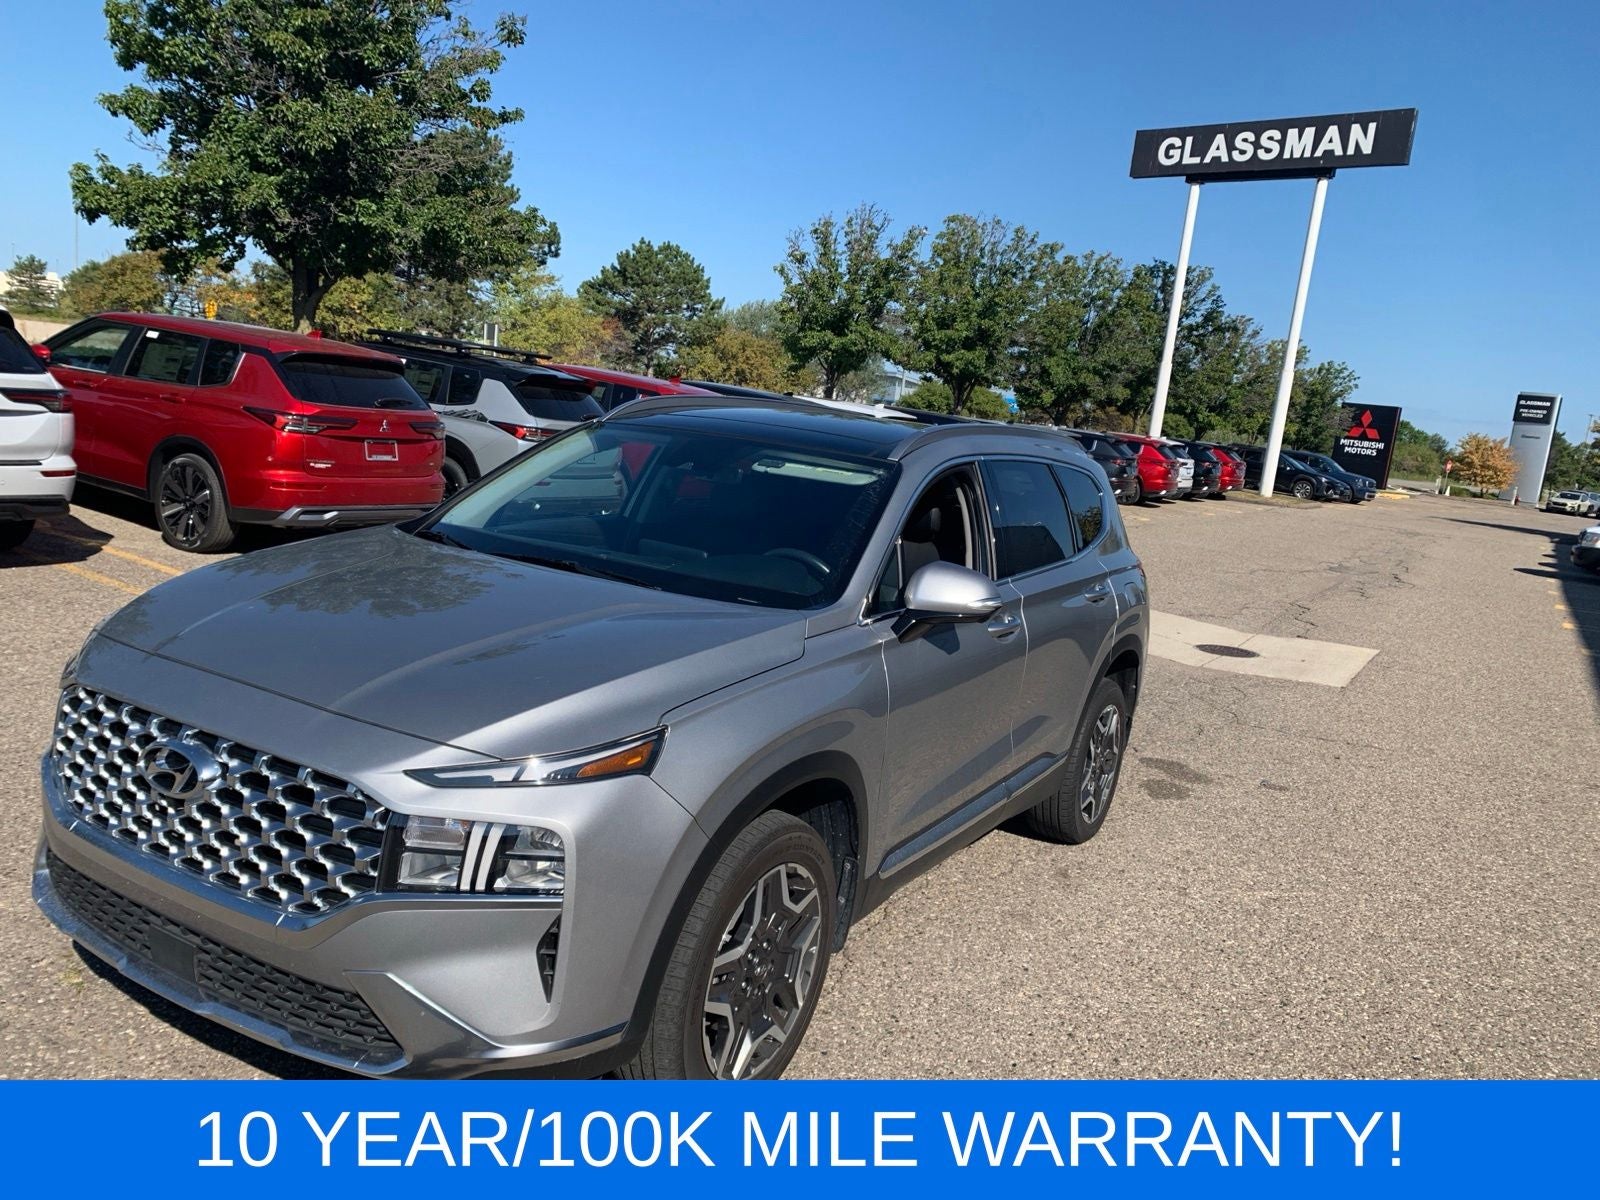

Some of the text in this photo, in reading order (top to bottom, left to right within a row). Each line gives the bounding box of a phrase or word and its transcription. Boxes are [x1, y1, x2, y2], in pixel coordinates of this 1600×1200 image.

[1157, 122, 1377, 166] GLASSMAN
[1339, 438, 1385, 450] MITSUBISHI
[1344, 446, 1377, 456] MOTORS
